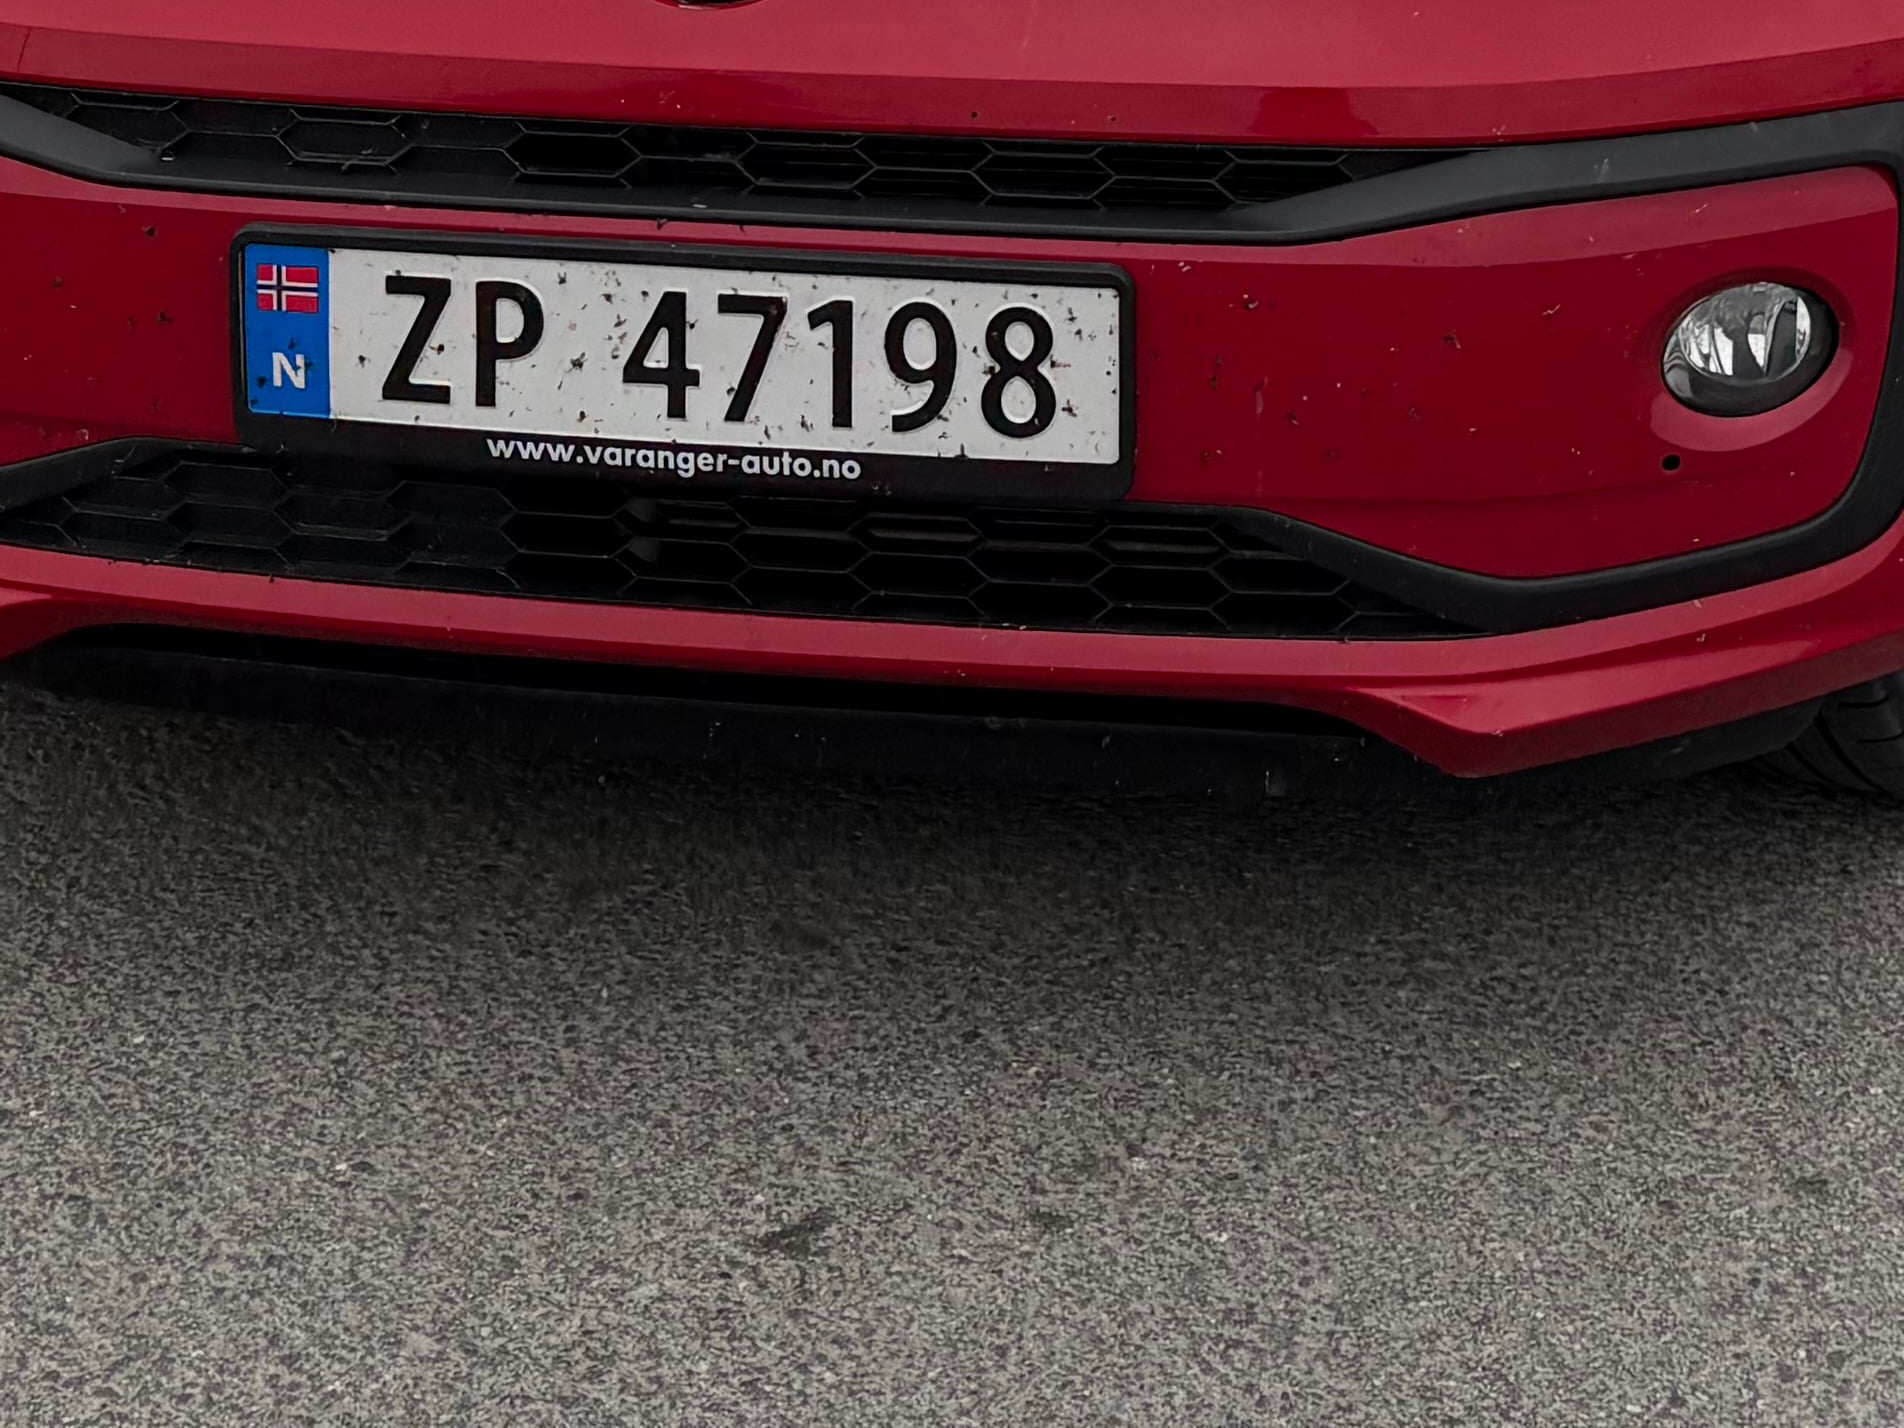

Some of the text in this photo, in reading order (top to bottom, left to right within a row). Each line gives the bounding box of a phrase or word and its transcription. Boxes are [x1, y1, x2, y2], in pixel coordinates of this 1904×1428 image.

[272, 351, 306, 390] N
[381, 274, 1058, 439] ZP 47198
[486, 437, 862, 481] www.varanger-auto.no
